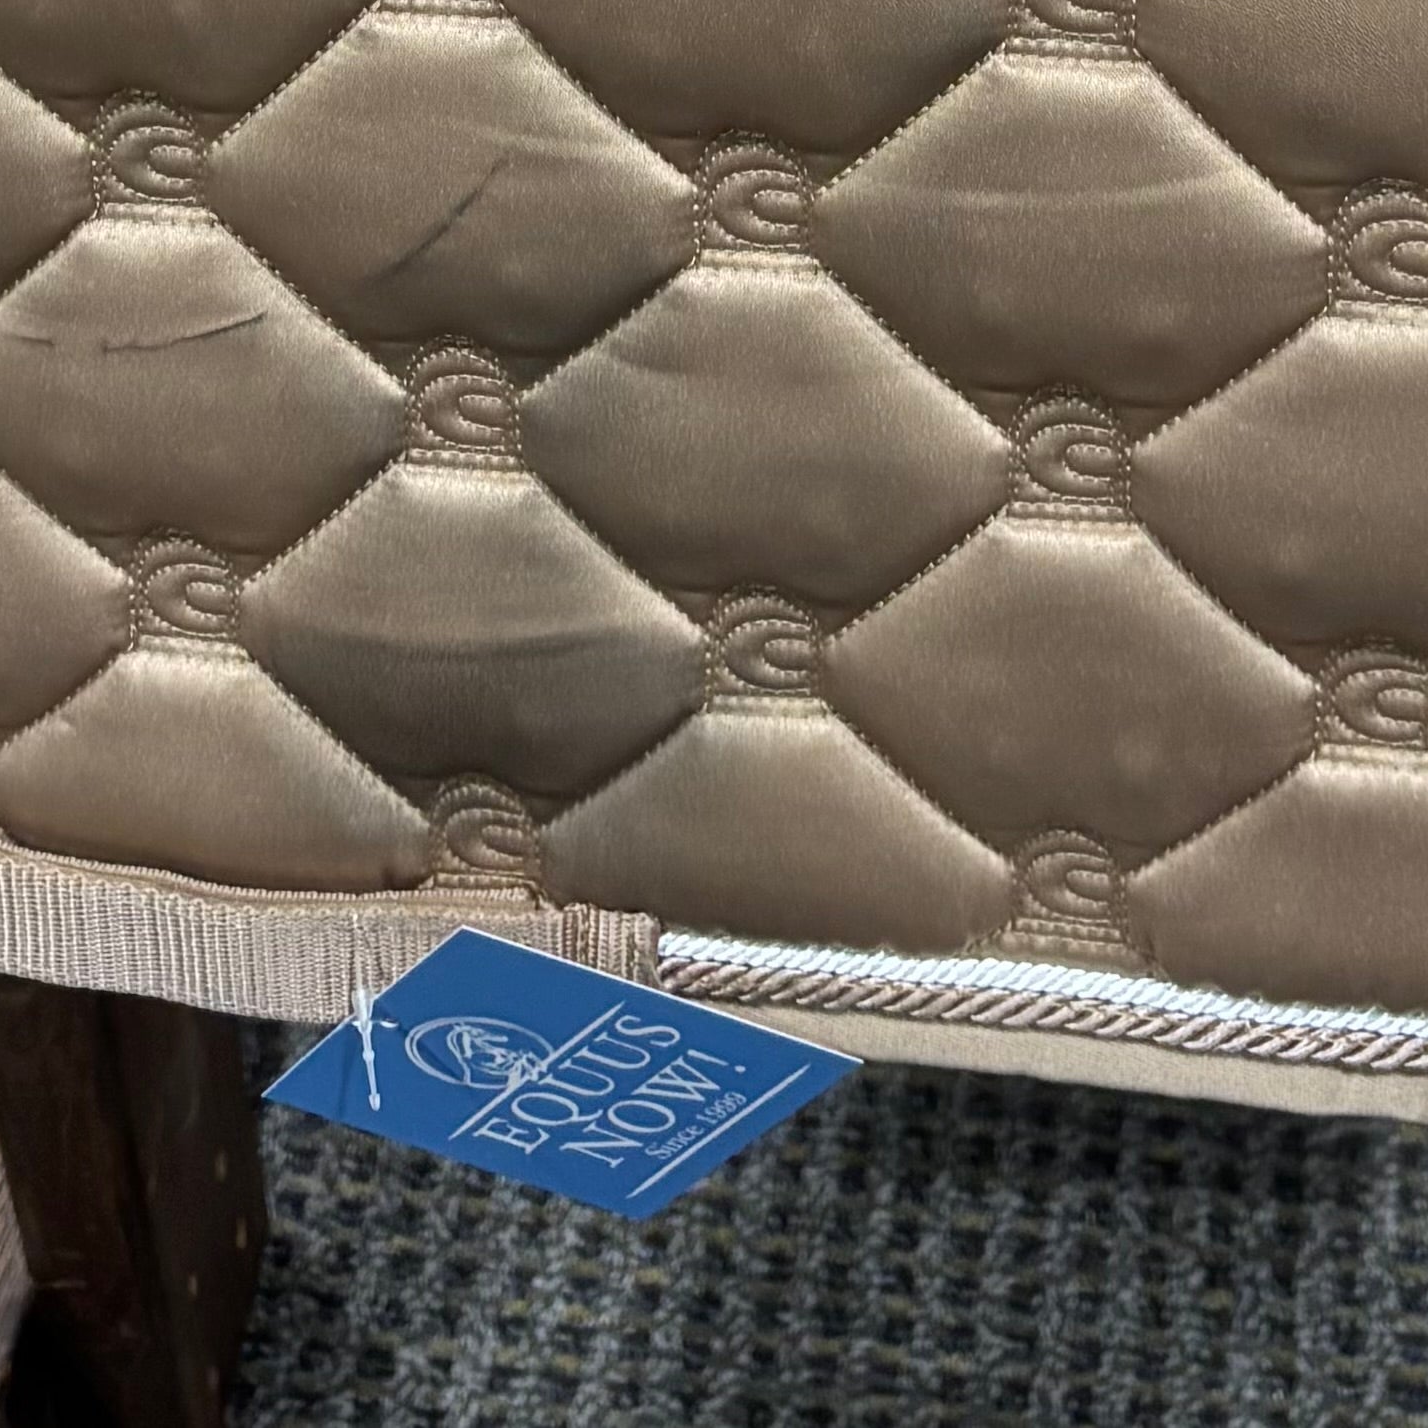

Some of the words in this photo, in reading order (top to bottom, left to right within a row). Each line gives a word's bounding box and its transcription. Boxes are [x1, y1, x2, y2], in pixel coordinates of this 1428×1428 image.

[473, 1014, 680, 1155] EQUUS
[559, 1049, 746, 1168] NOW!
[644, 1125, 705, 1160] Since
